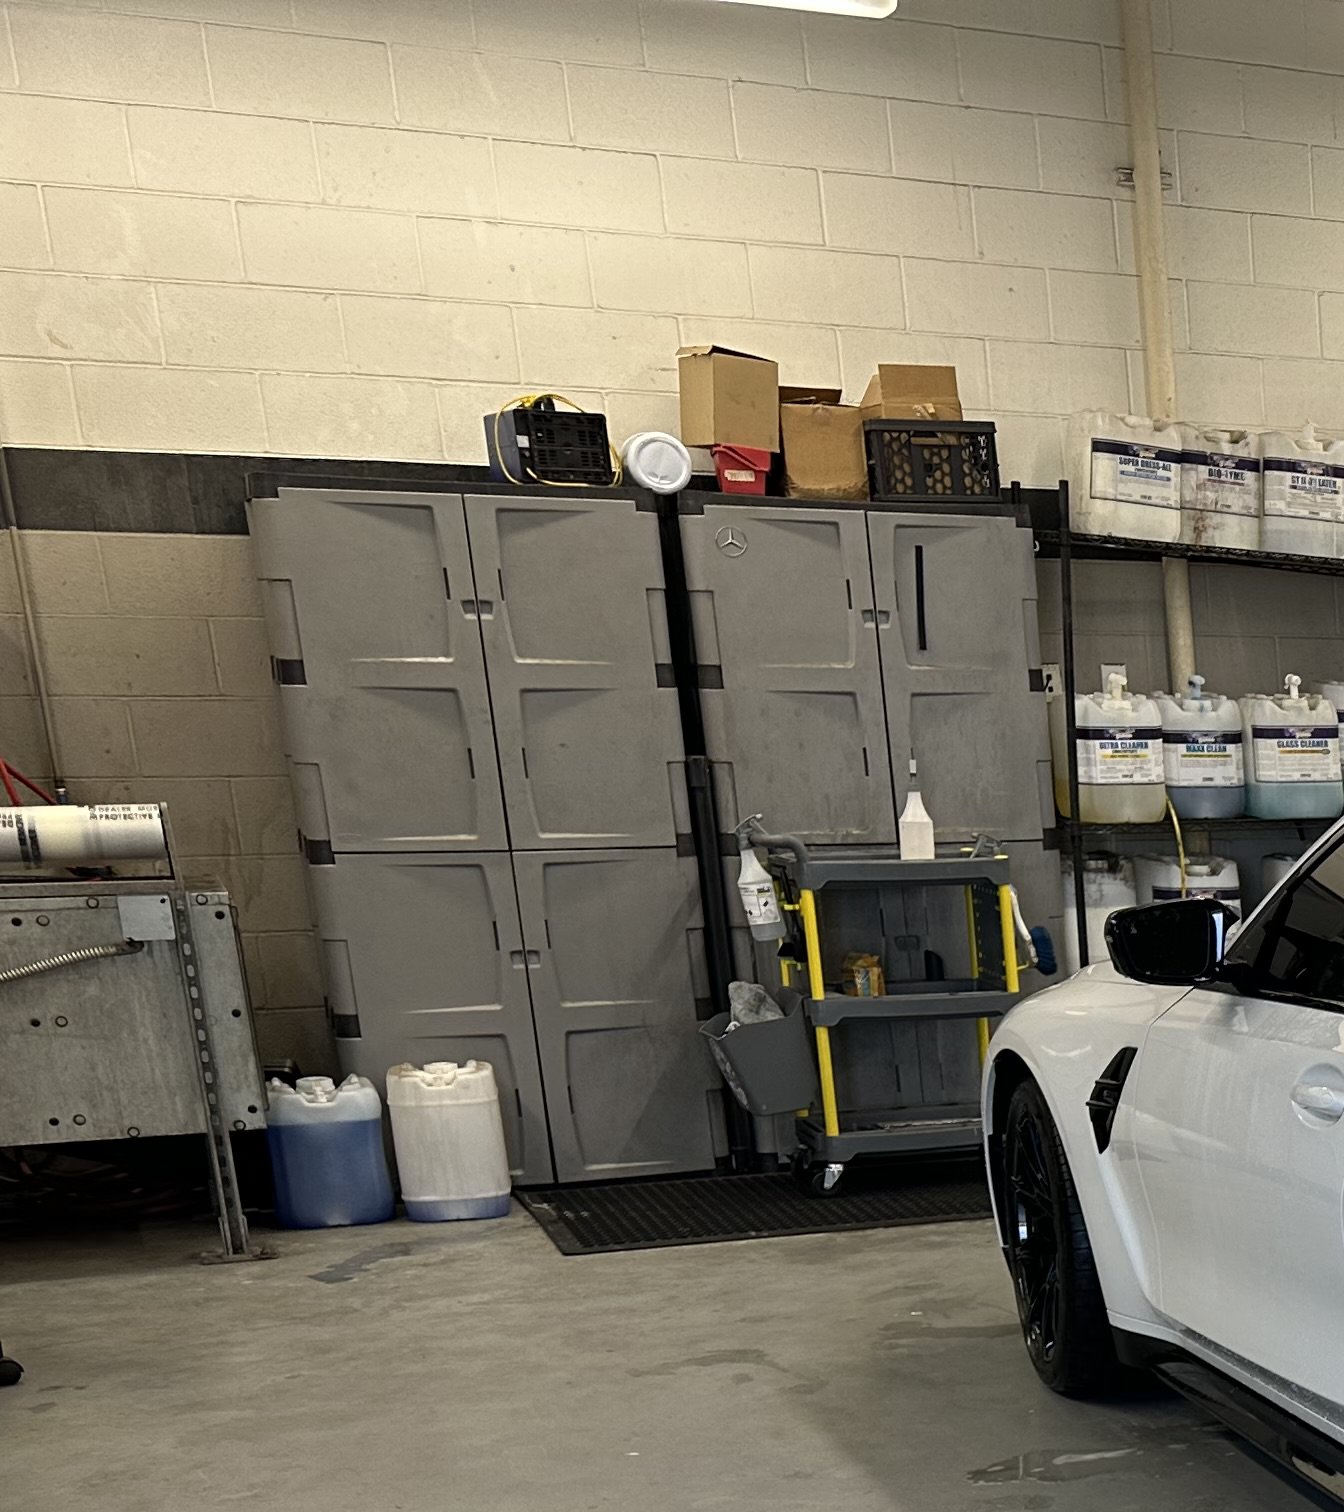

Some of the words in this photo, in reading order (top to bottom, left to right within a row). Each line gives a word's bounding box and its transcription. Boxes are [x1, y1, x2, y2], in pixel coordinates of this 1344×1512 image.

[1118, 456, 1140, 468] SUPER
[1120, 741, 1149, 750] CLEANER
[1206, 744, 1227, 753] CLEAN
[1276, 740, 1299, 748] GLASS
[1300, 740, 1329, 748] CLEANER
[98, 812, 153, 821] PROTECTIVE
